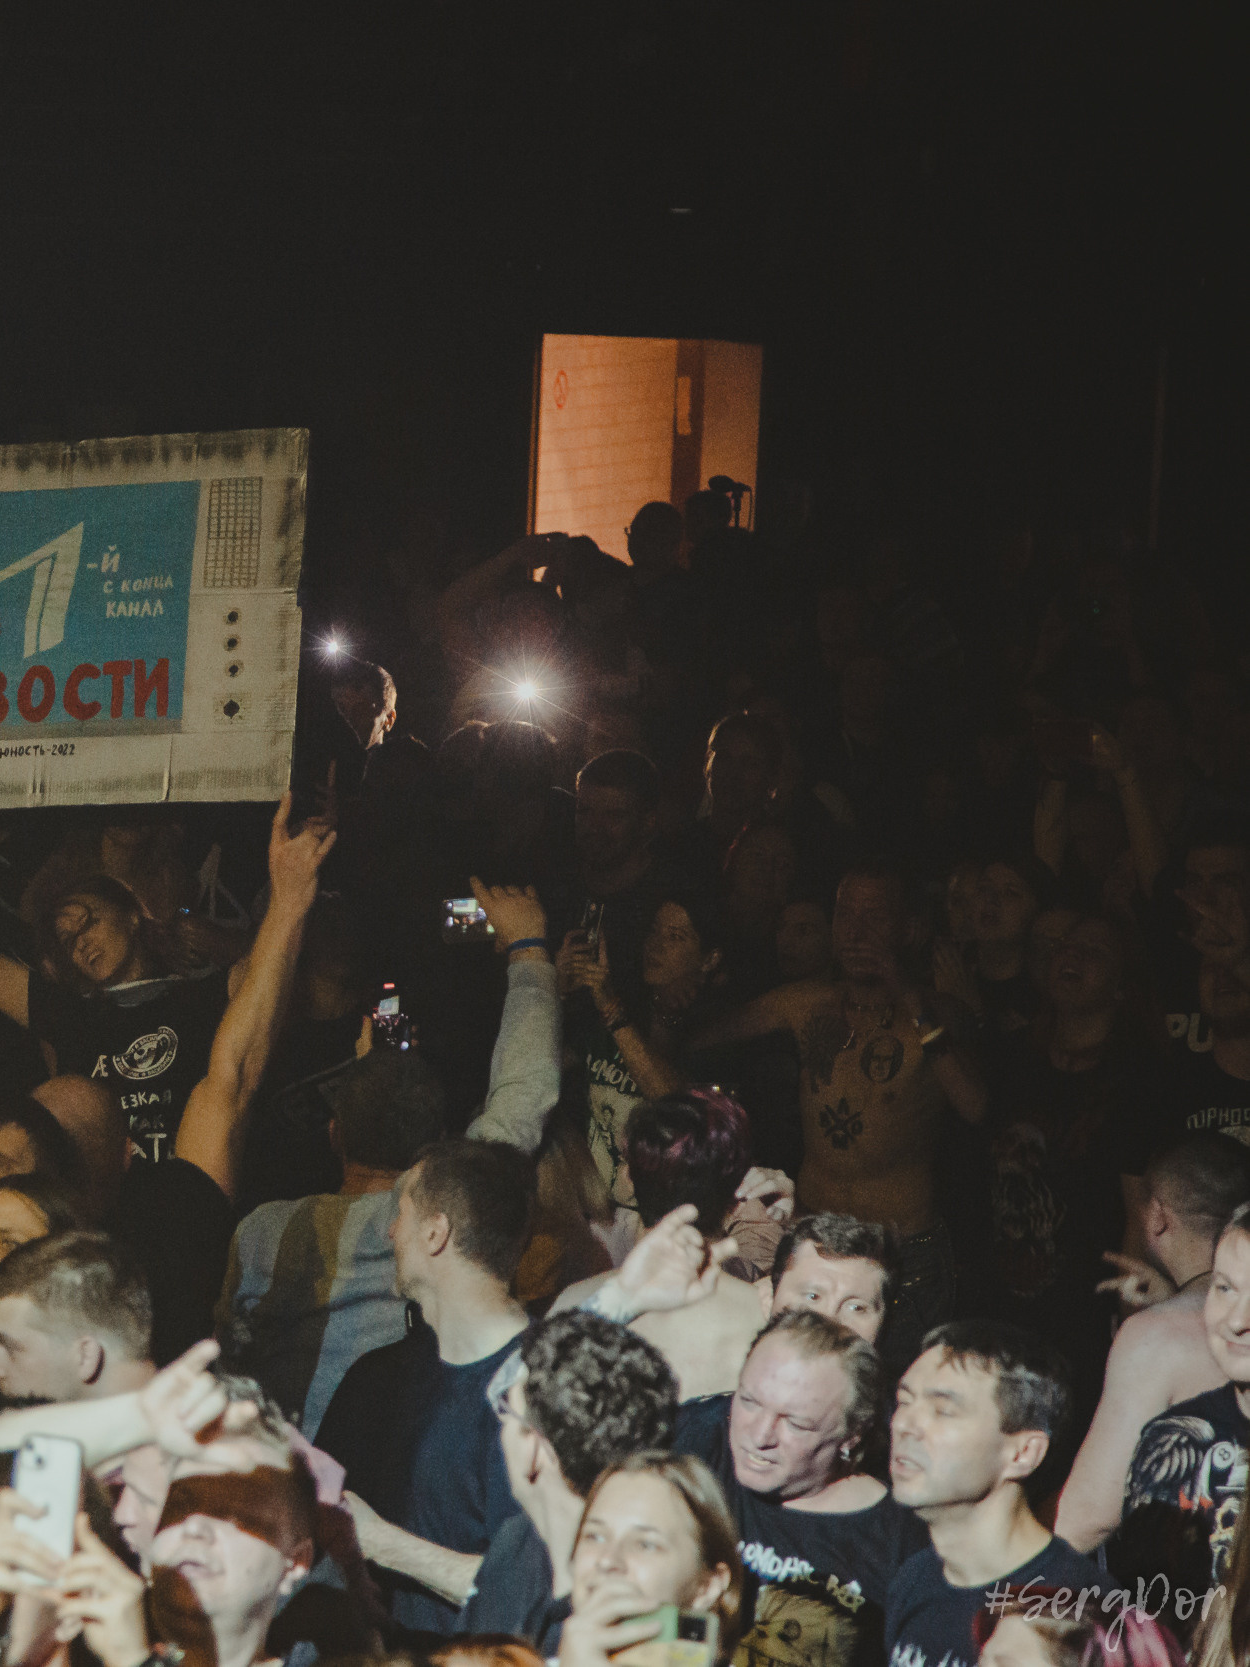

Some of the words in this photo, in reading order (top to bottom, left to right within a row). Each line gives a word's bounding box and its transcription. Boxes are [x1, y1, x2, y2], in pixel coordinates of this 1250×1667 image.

[103, 579, 114, 594] С
[120, 573, 174, 594] КОНЦА
[105, 598, 165, 619] КАНАЛ
